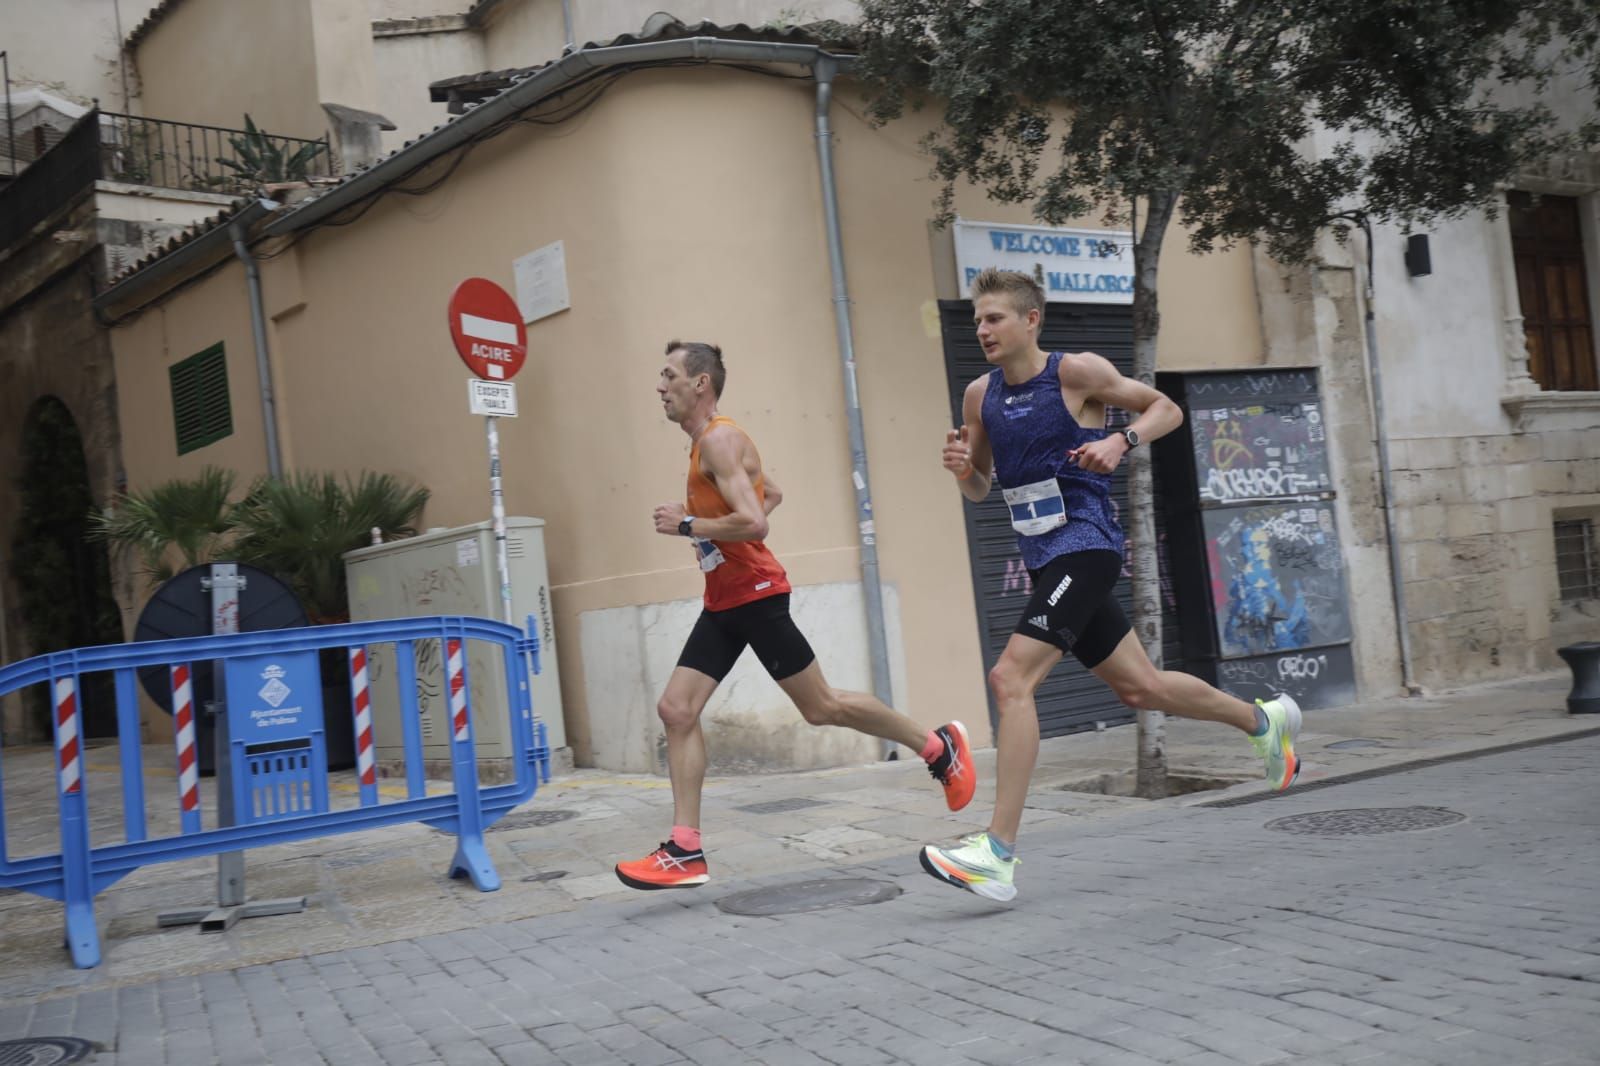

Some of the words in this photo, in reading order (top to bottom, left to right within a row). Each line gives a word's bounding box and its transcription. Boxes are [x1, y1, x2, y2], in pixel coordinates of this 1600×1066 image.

[989, 231, 1080, 256] WELCOME
[471, 343, 513, 362] ACIRE
[1027, 502, 1037, 519] 1
